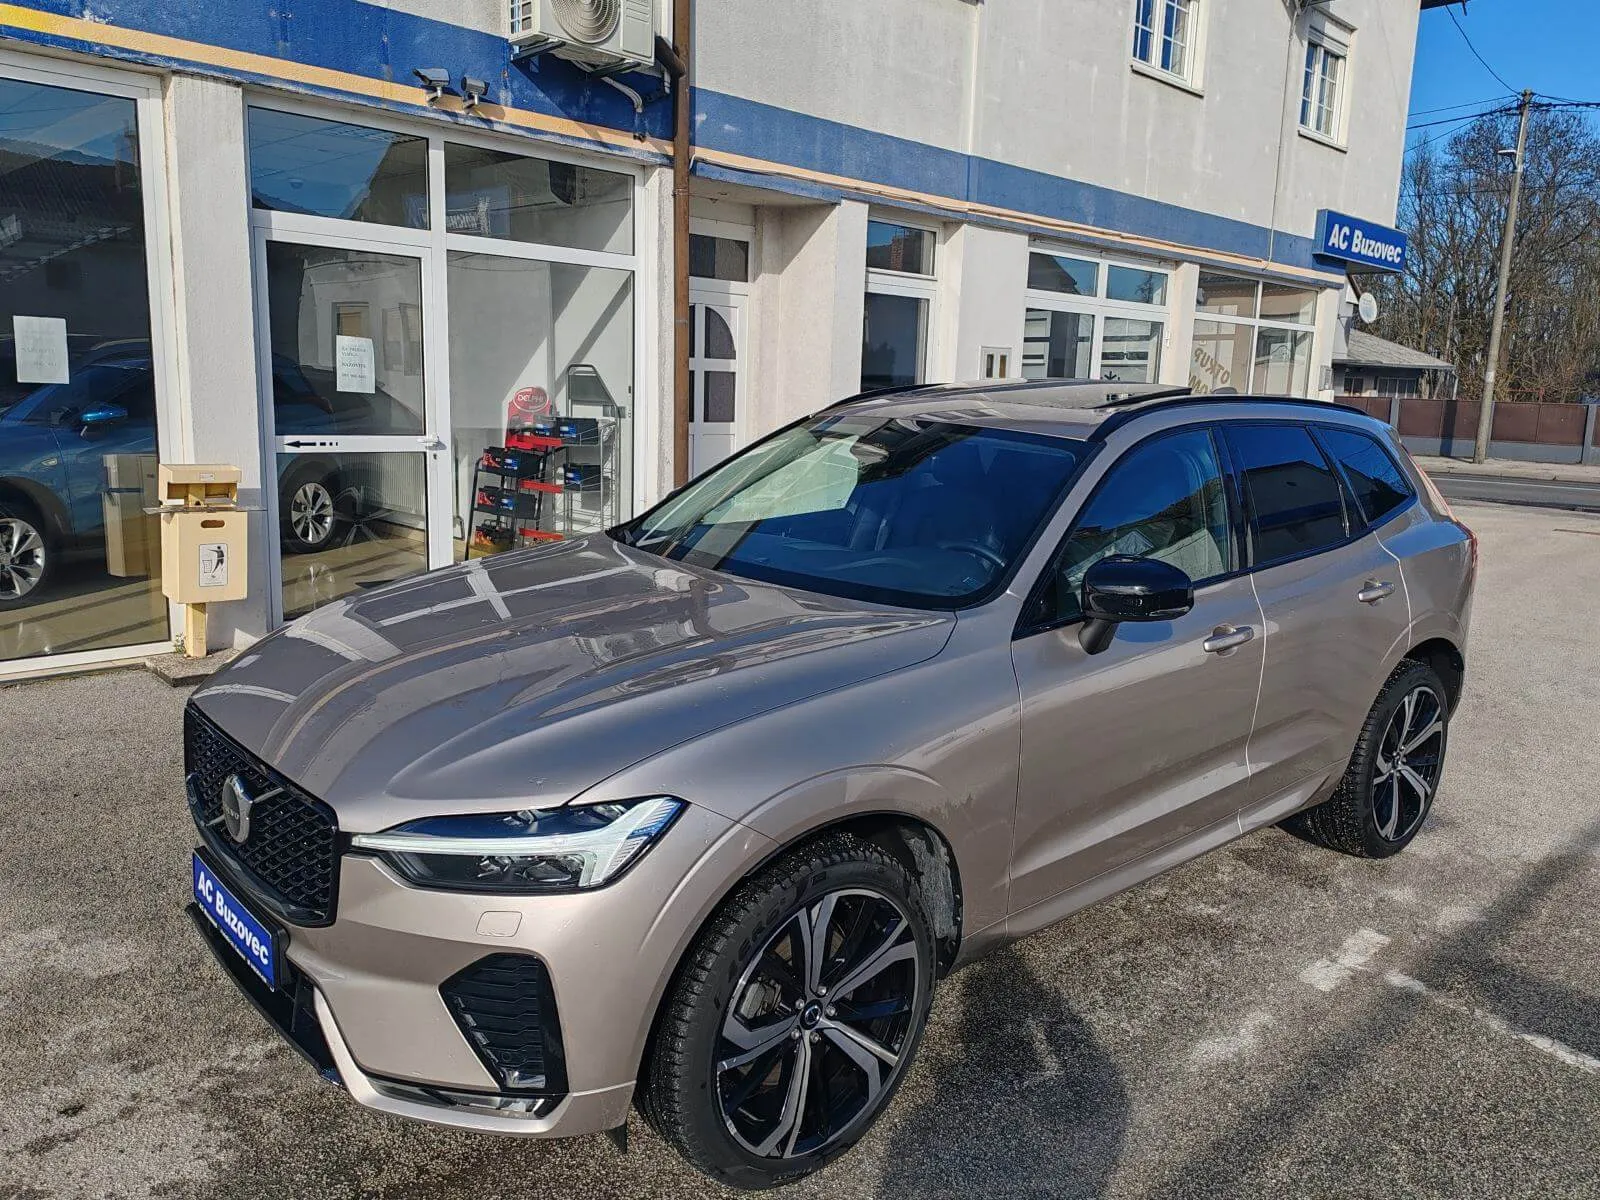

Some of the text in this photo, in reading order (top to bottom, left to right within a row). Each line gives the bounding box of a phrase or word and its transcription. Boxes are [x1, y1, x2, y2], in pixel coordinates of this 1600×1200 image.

[1328, 224, 1402, 264] AC Buzovec
[198, 871, 213, 903] AC
[215, 889, 269, 966] Buzovec
